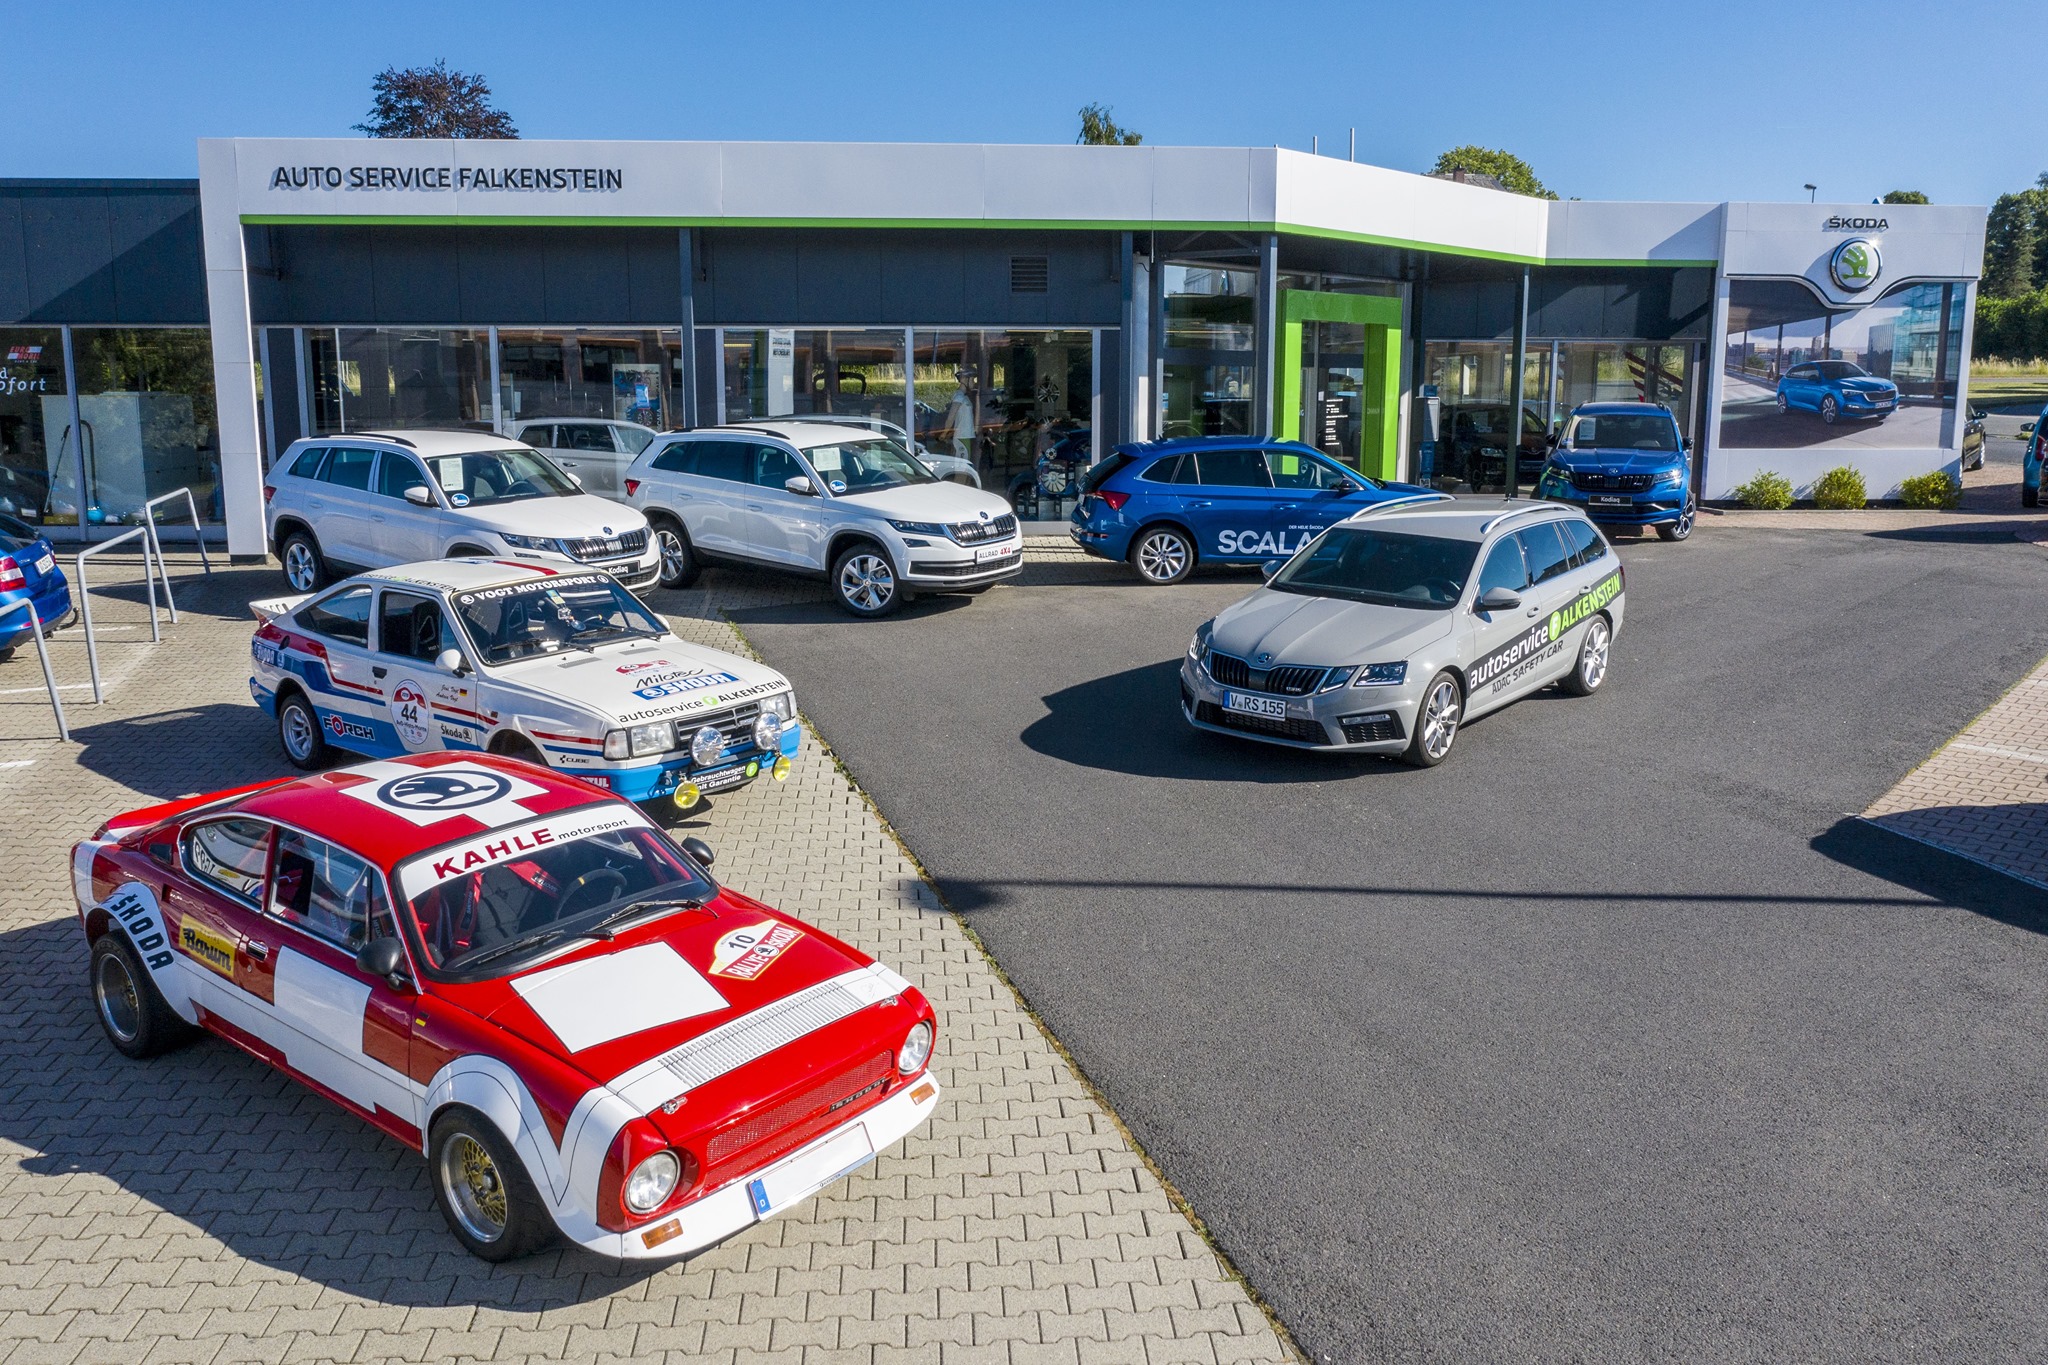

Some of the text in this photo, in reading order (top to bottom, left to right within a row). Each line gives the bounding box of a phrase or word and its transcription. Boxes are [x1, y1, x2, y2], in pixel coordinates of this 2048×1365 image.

[274, 166, 623, 189] AUTO SERVICE FALKENSTEIN
[1829, 215, 1889, 229] ŠKODA
[1600, 496, 1621, 504] Kodiaq
[608, 565, 629, 575] Kodiaq
[474, 576, 597, 601] VOGT MOTORSPORT
[1470, 624, 1548, 689] autoservice
[1492, 640, 1564, 694] ADAC SAFETY CAR
[401, 703, 418, 723] 44
[619, 700, 704, 723] autoservice
[1230, 694, 1284, 715] V RS 155
[440, 723, 463, 739] Škoda
[690, 765, 746, 784] Gebrauchtwagen
[709, 775, 742, 788] Garantie
[432, 818, 629, 879] KAHLE motorsport
[110, 893, 174, 971] ŠKODA
[728, 934, 756, 949] 10
[726, 953, 769, 978] RALLYE
[759, 1199, 766, 1208] D
